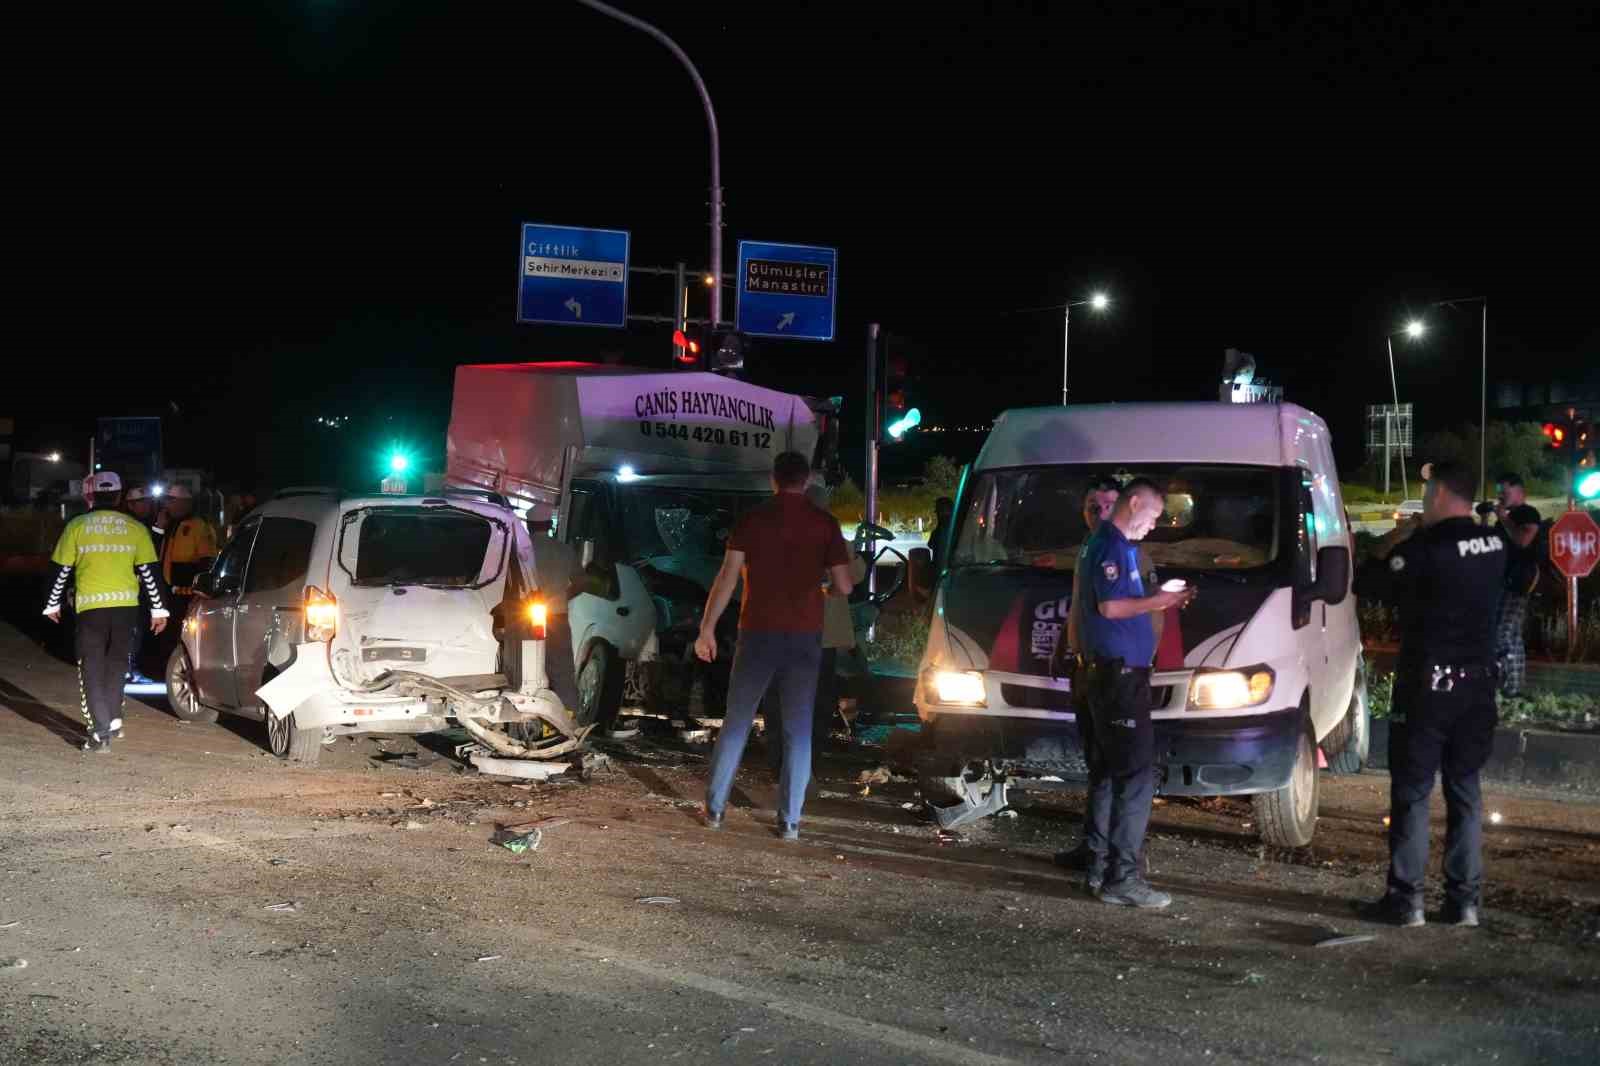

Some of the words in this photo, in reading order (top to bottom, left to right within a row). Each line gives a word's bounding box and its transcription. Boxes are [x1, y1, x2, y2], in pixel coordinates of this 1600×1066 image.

[561, 264, 608, 277] Merkezi
[682, 391, 776, 432] HAYVANCILIK
[641, 421, 652, 436] 0
[656, 422, 689, 441] 544
[692, 426, 725, 445] 420
[1554, 531, 1597, 556] DUR
